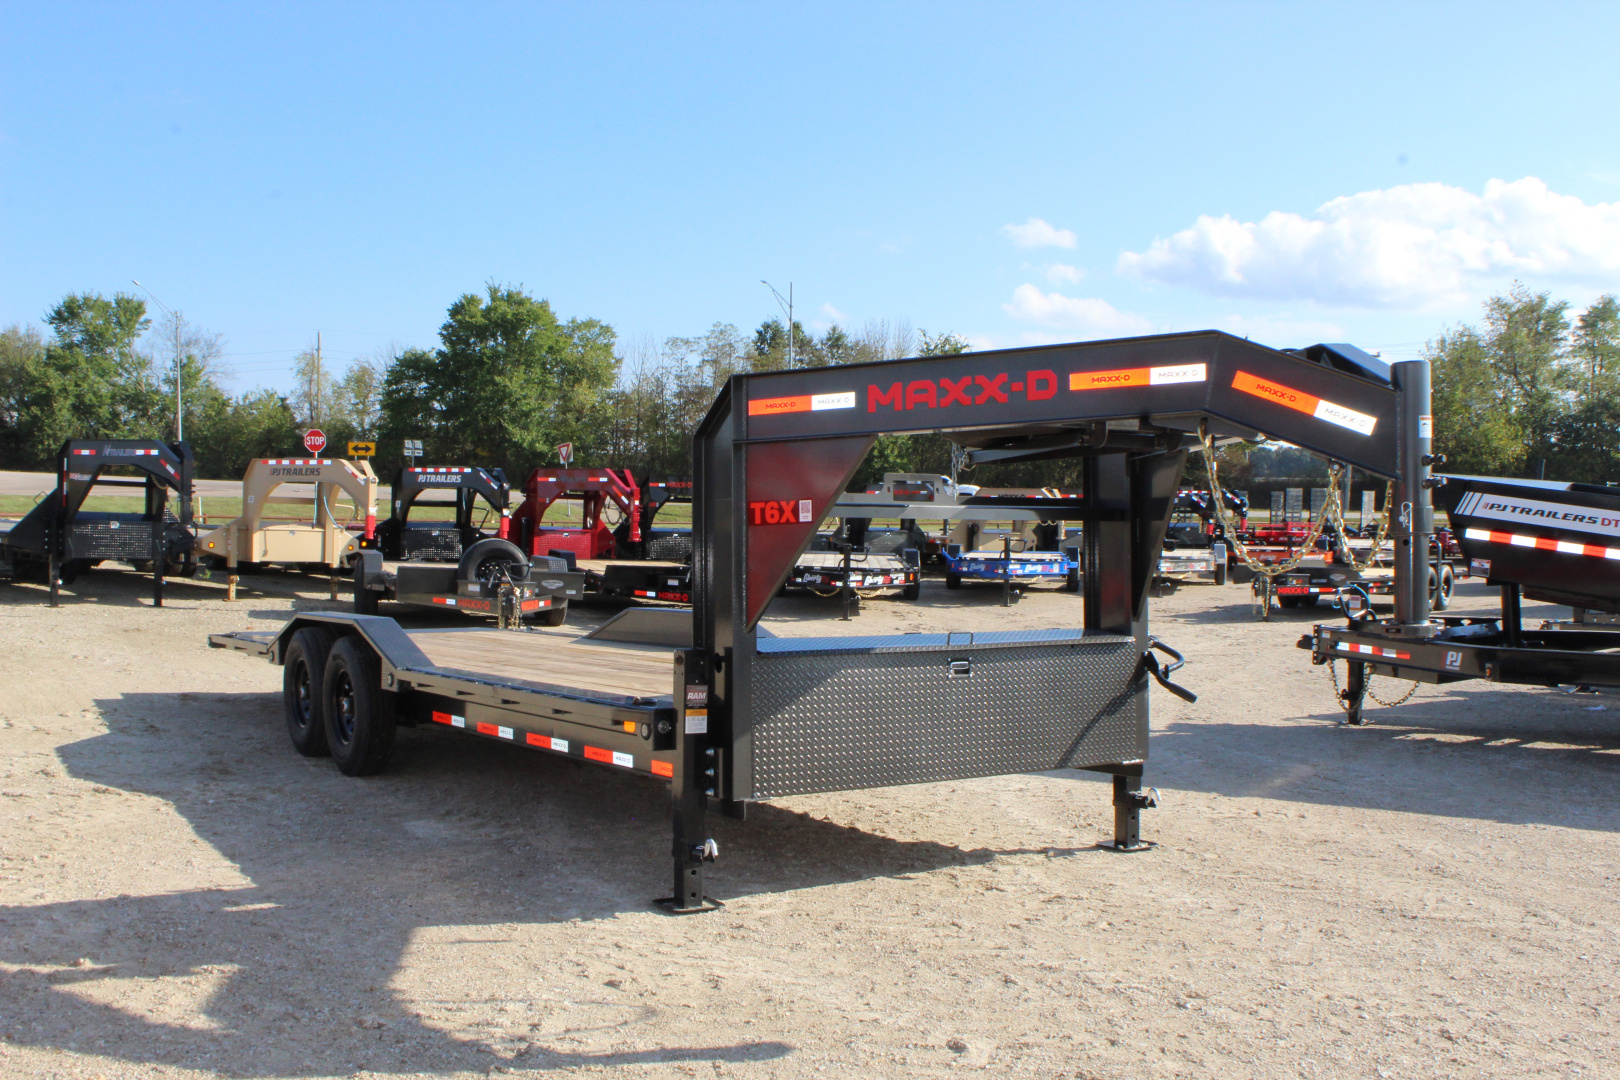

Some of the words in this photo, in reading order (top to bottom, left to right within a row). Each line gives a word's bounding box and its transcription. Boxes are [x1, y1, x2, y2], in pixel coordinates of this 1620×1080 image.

[1091, 374, 1131, 384] MAXX-D
[1158, 369, 1199, 378] MAXX-D
[867, 369, 1058, 413] MAXX-D
[765, 401, 796, 409] MAXX-D
[817, 397, 850, 405] MAXX-D
[1255, 383, 1297, 403] MAXX-D
[1324, 407, 1367, 428] MAXX-D
[306, 436, 324, 445] STOP
[750, 500, 797, 525] T6X
[658, 591, 688, 602] MAXX-D
[457, 598, 490, 611] MAXX-D
[1445, 651, 1463, 666] PJ
[687, 692, 706, 700] RAM
